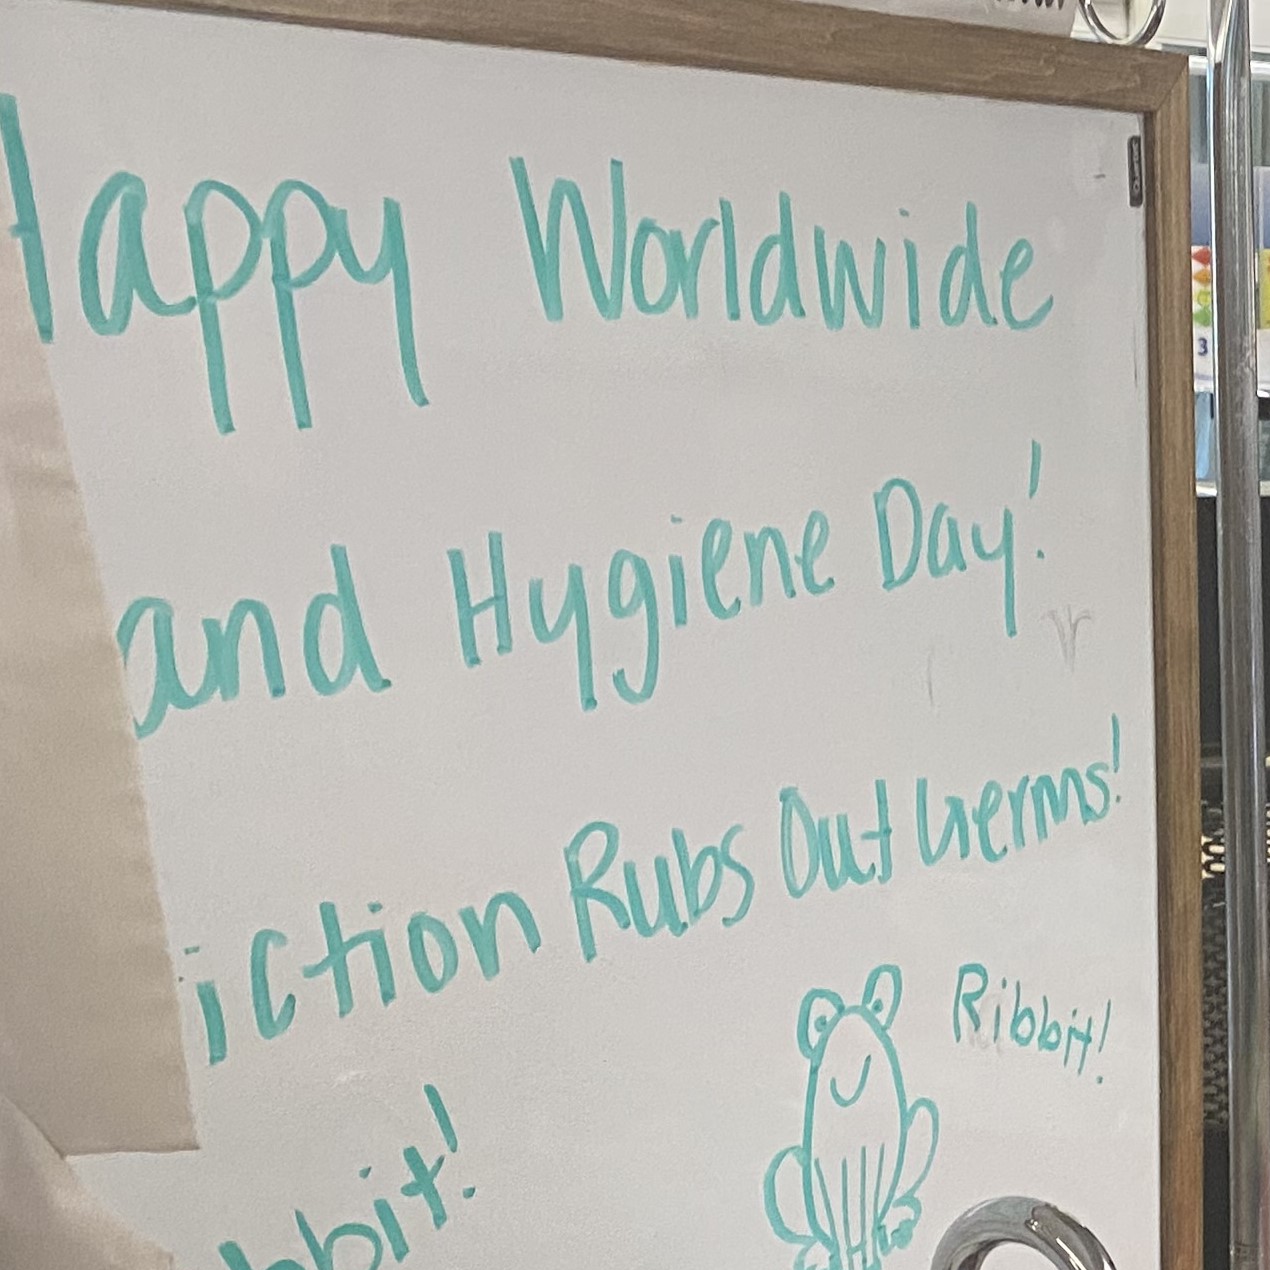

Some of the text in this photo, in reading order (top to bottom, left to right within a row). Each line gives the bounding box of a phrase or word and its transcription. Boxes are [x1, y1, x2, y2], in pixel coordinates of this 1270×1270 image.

[509, 156, 1054, 330] Worldwide
[1197, 337, 1208, 357] 3
[117, 439, 1045, 739] and Hygiene Day!
[183, 893, 542, 1066] iction
[564, 820, 755, 963] Rubs
[780, 778, 893, 898] Out
[953, 962, 1112, 1085] Ribbit!
